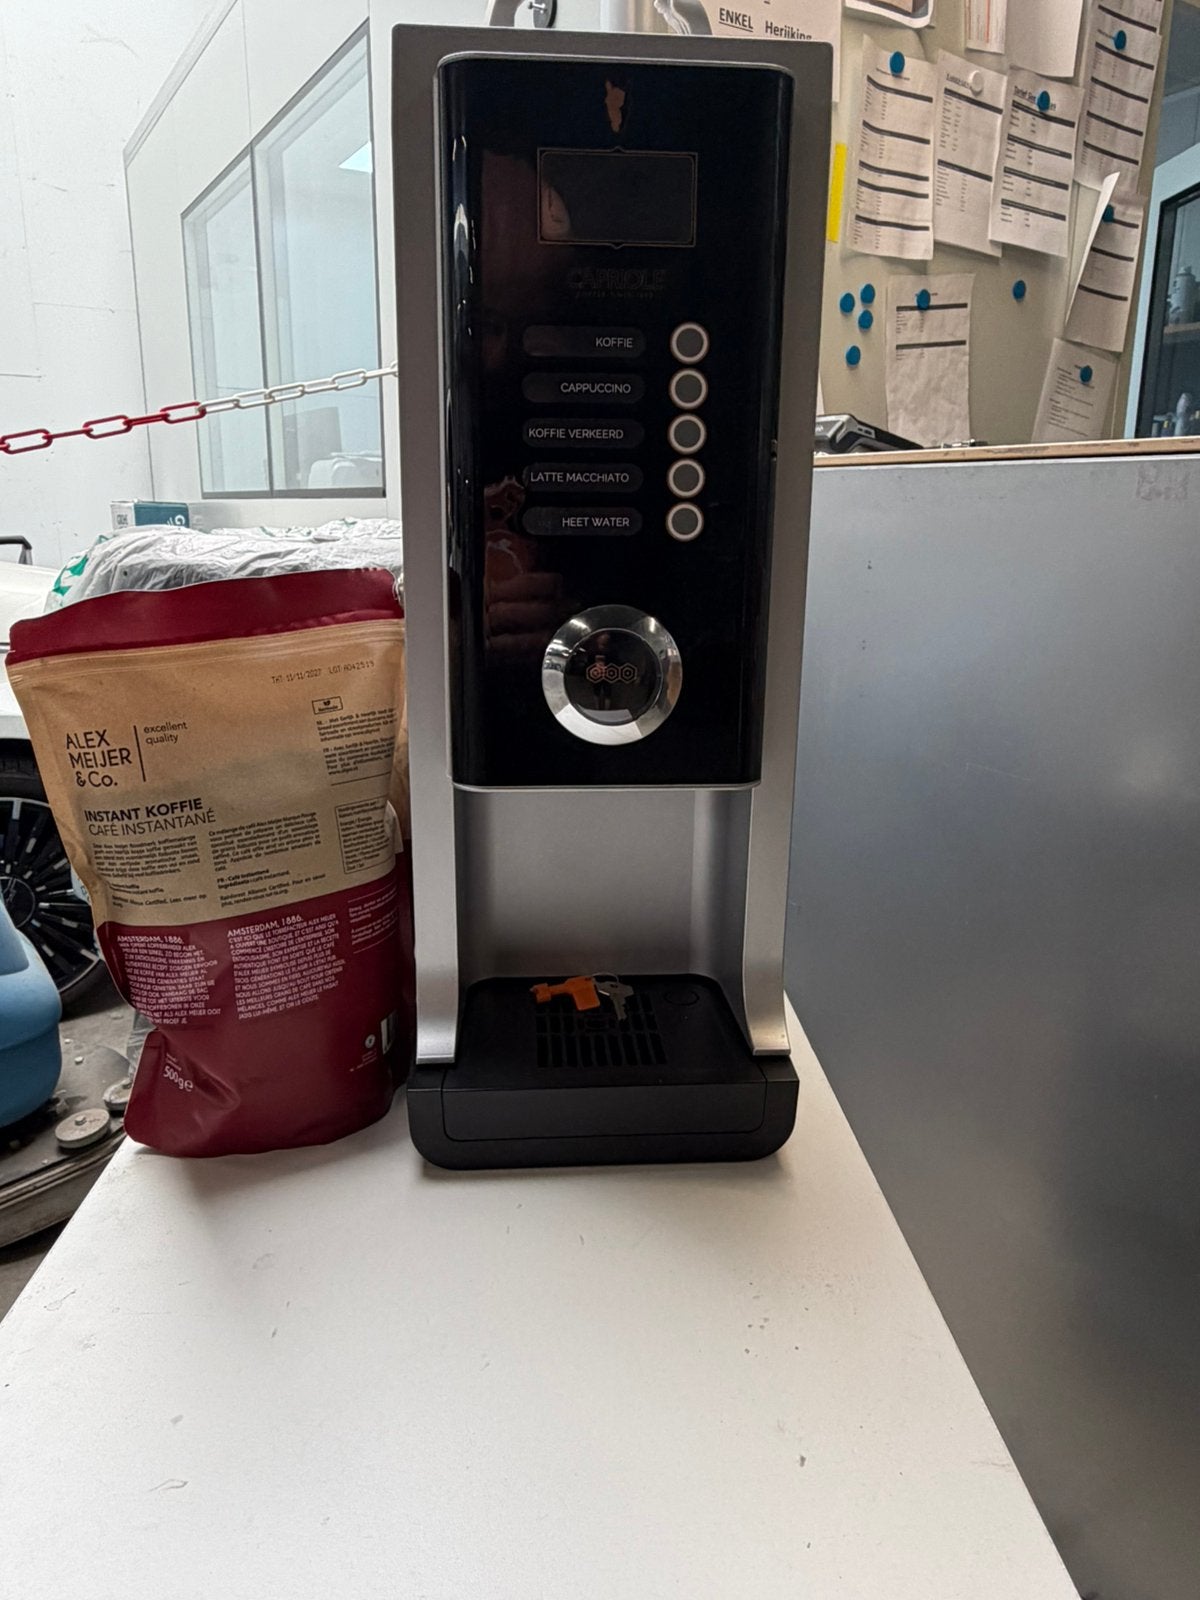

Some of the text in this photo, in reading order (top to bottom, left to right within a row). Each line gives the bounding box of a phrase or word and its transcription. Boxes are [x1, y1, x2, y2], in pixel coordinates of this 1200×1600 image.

[719, 7, 753, 30] ENKEL
[595, 337, 633, 348] KOFFIE
[560, 382, 631, 394] CAPPUCCINO
[528, 428, 624, 439] KOFFIE VERKEERD
[530, 471, 630, 483] LATTE MACCHIATO
[562, 517, 630, 528] HEET WATER
[143, 722, 188, 734] excellent
[66, 729, 110, 750] ALEX
[145, 733, 179, 746] quality
[68, 747, 132, 769] MEIJER
[75, 770, 118, 788] & Co.
[84, 798, 203, 822] INSTANT KOFFIE
[88, 808, 216, 836] CAFÉ INSTANTANÉ
[227, 914, 303, 938] AMSTERDAM, 1886.
